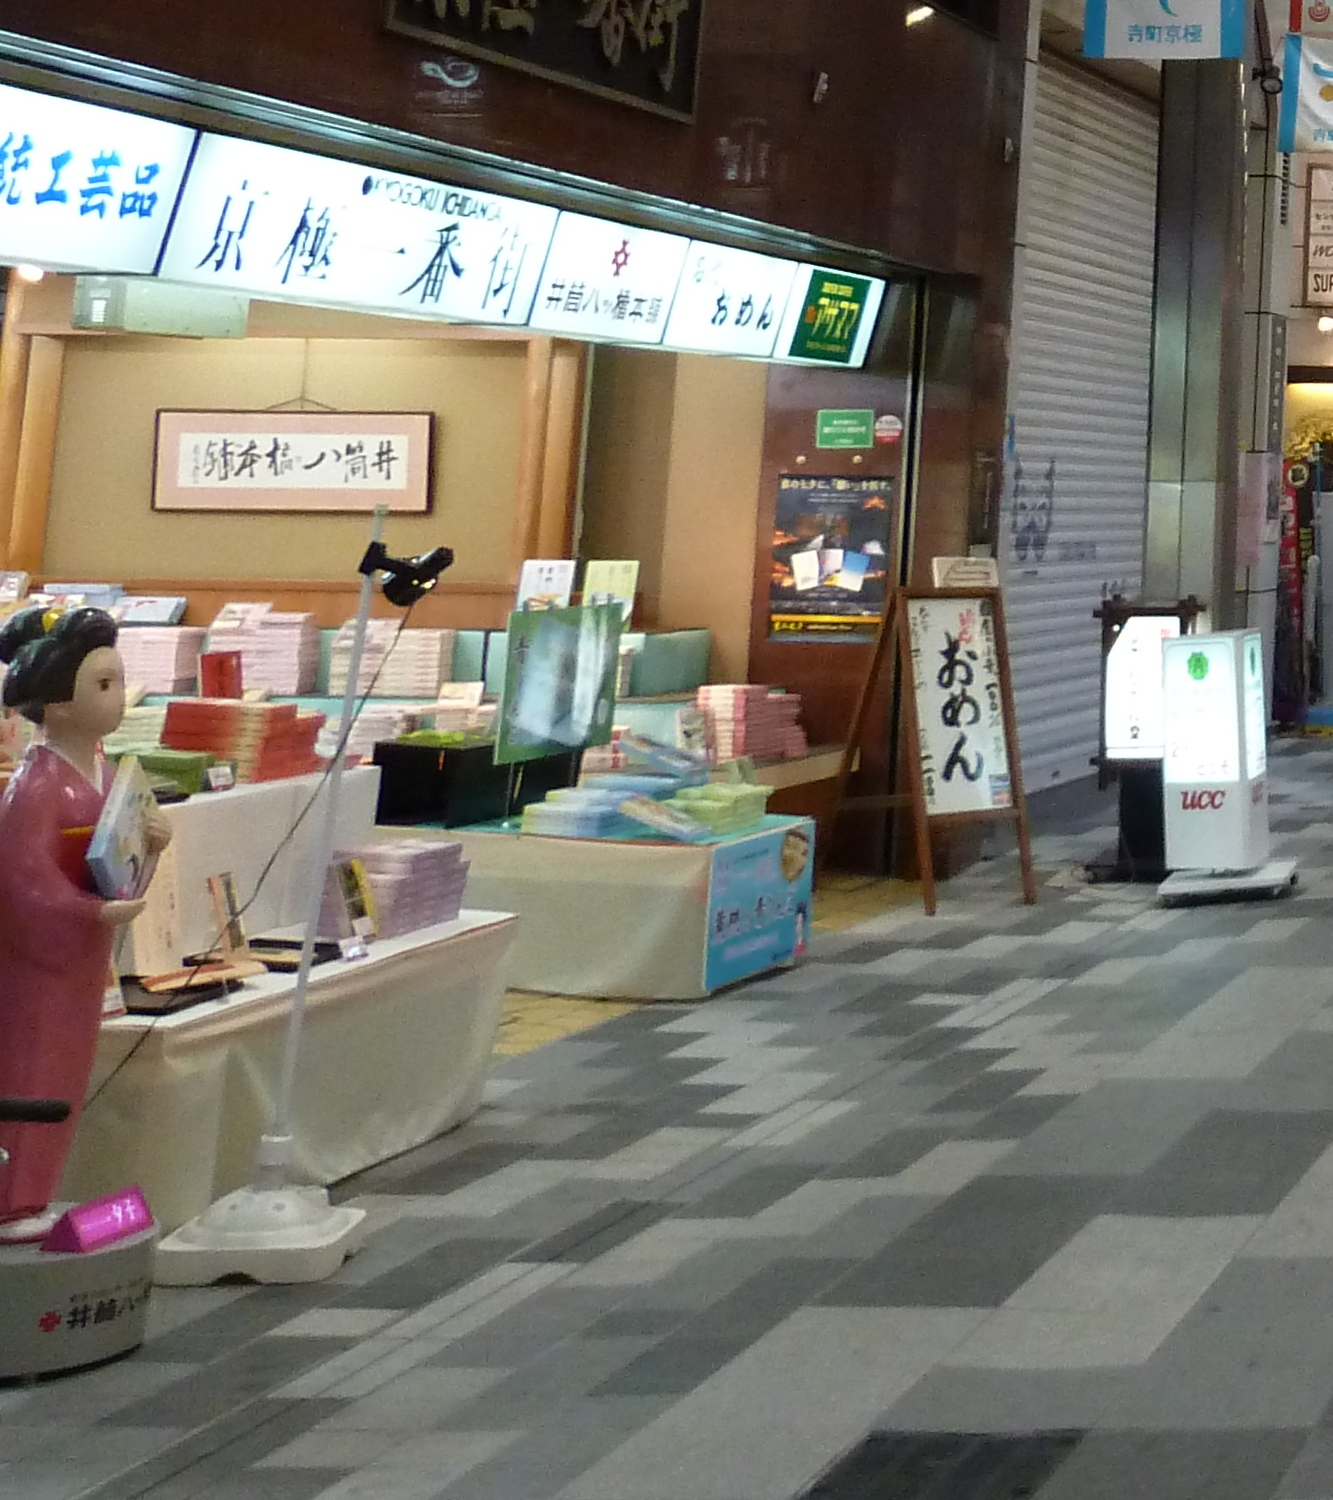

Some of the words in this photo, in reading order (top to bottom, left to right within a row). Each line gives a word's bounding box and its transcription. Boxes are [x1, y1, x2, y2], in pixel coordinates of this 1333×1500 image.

[1127, 25, 1203, 44] 寺町京極
[199, 180, 531, 318] 京極一番街
[711, 288, 774, 331] おめん
[937, 631, 983, 783] おめん
